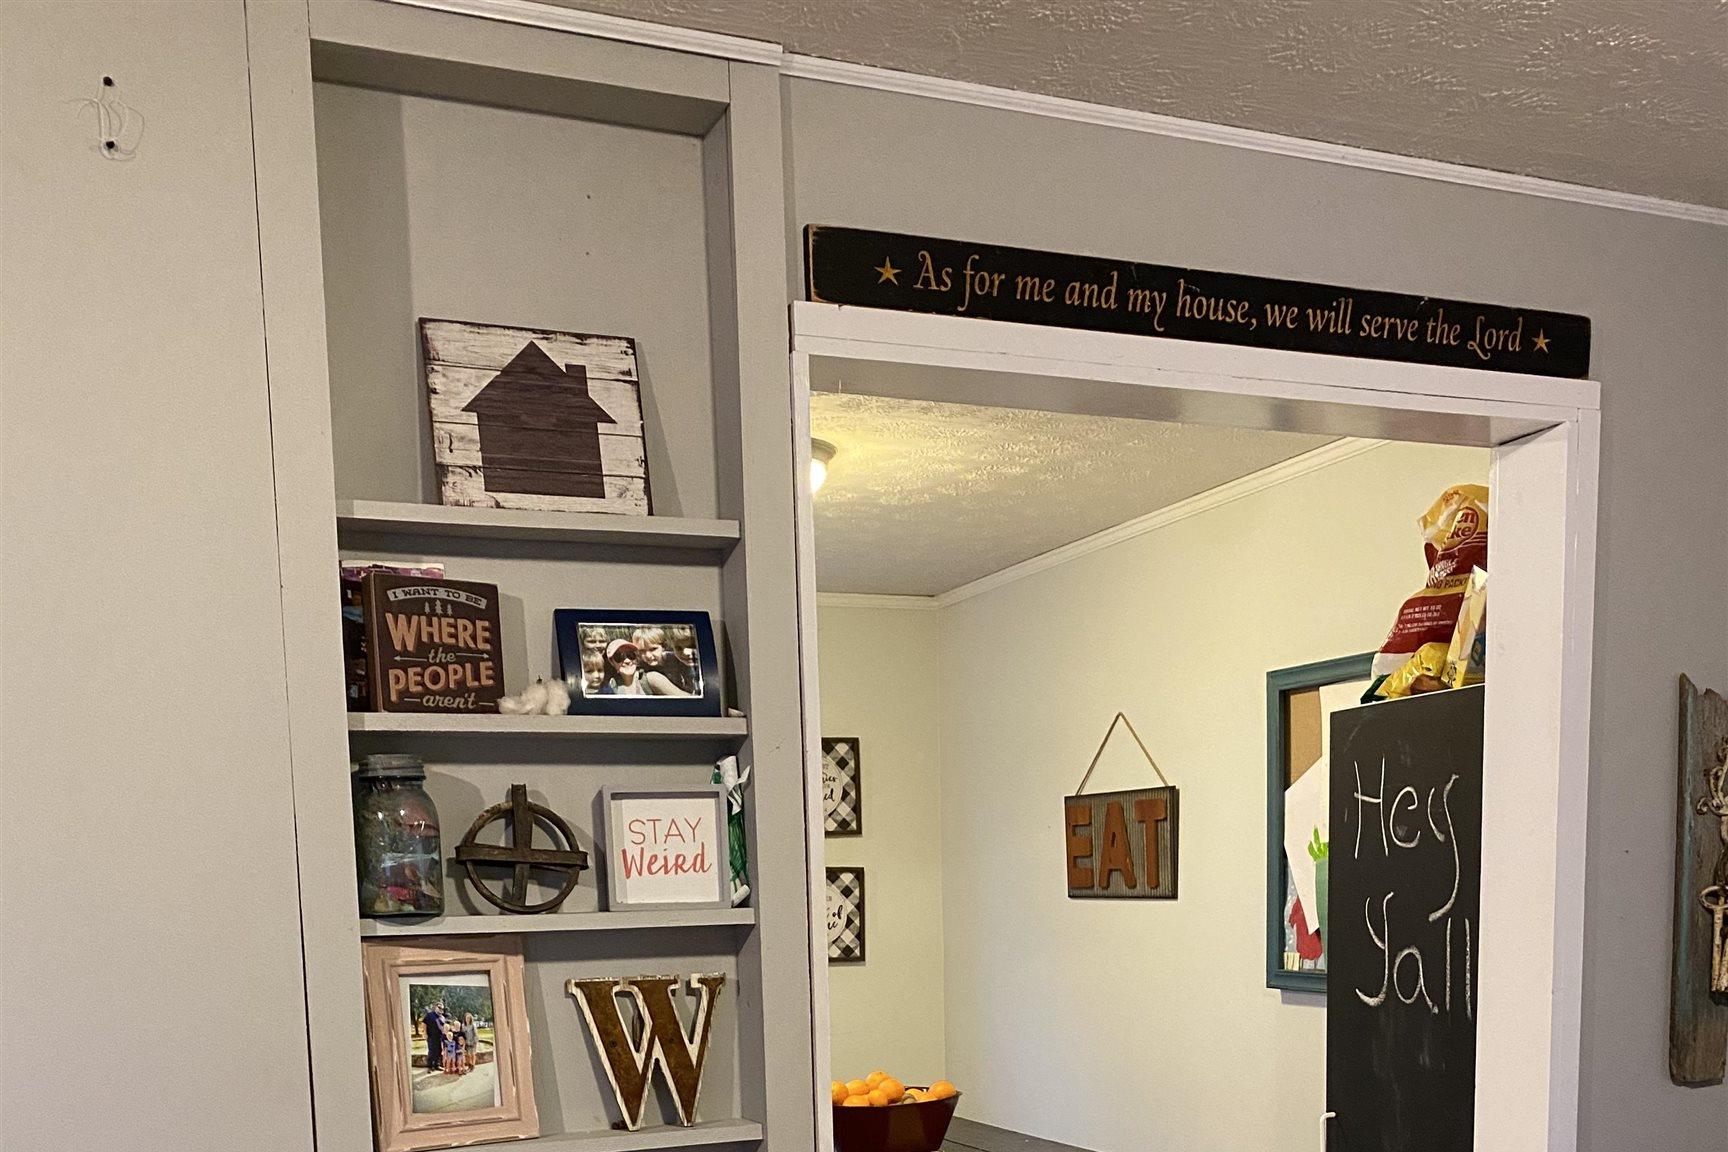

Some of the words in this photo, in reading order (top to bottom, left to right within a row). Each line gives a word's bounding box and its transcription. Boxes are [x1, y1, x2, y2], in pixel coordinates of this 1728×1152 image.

[913, 250, 953, 292] As
[957, 254, 1005, 312] for
[1016, 274, 1056, 302] me
[1065, 271, 1119, 311] and
[1127, 288, 1167, 331] my
[1176, 279, 1258, 331] house,
[1264, 302, 1298, 329] we
[1306, 298, 1353, 335] will
[1360, 313, 1419, 342] serve
[1426, 308, 1462, 346] the
[1467, 315, 1523, 360] Lord
[392, 590, 399, 599] I
[403, 587, 440, 598] WANT
[444, 589, 461, 600] TO
[464, 594, 483, 607] BE
[385, 611, 492, 654] WHERE
[428, 647, 457, 664] the
[388, 661, 496, 704] PEOPLE
[422, 692, 478, 709] aren't
[628, 817, 702, 846] STAY
[1065, 798, 1168, 890] EAT
[1354, 753, 1459, 922] Hey
[621, 841, 713, 881] Weird
[565, 972, 727, 1132] W
